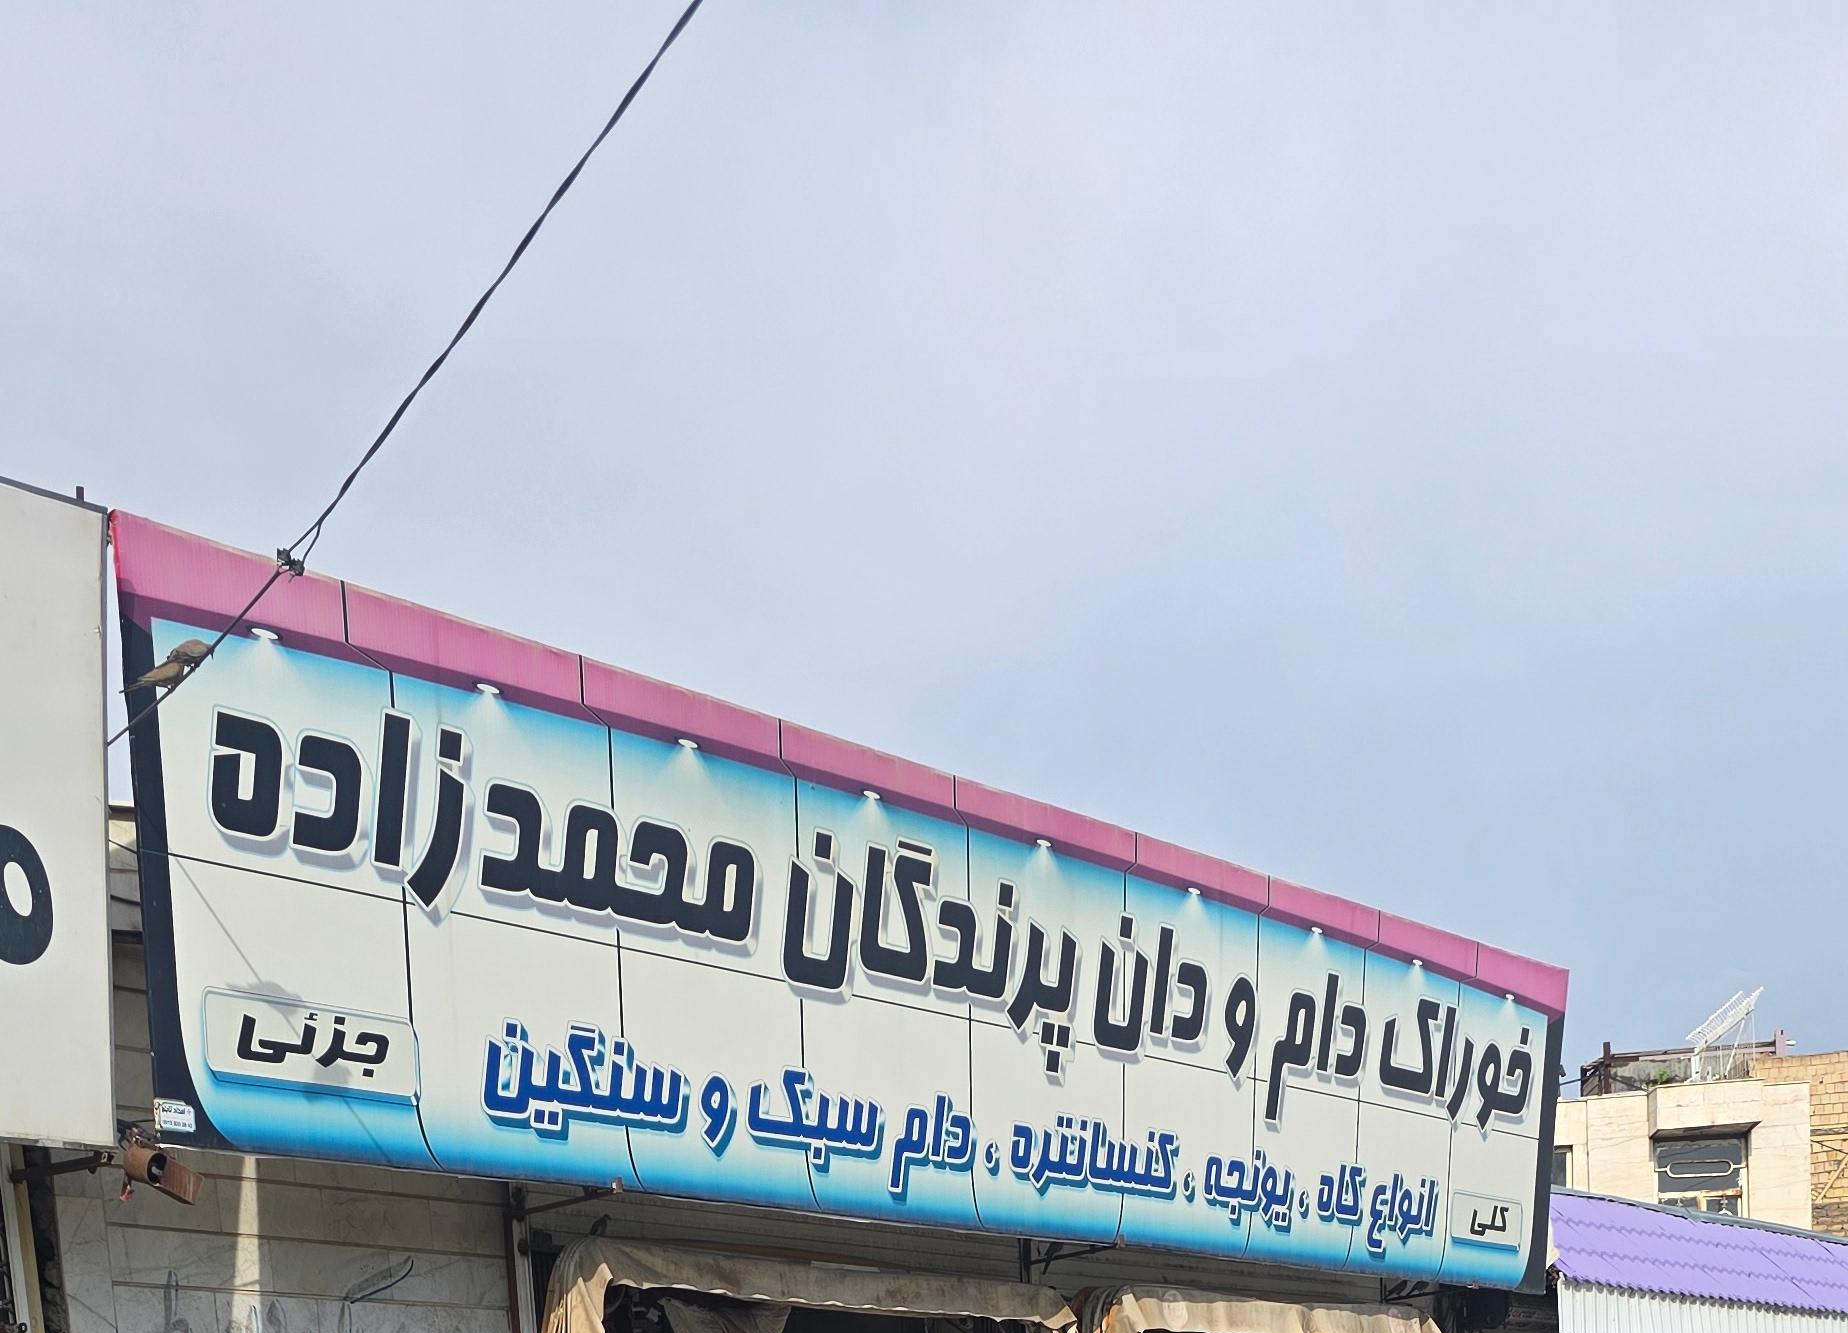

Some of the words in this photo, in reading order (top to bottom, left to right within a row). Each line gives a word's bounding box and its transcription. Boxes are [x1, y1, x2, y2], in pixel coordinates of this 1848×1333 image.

[210, 710, 756, 943] محمدزاده
[782, 830, 1078, 1075] پرندگان
[1092, 914, 1209, 1053] دان
[235, 1012, 391, 1079] جزئی
[482, 1021, 683, 1128] سنگین
[1223, 976, 1257, 1079] و
[1264, 972, 1368, 1122] دام
[1378, 997, 1533, 1132] خوراک
[699, 1075, 730, 1145] و
[746, 1069, 880, 1165] سبک
[889, 1093, 973, 1190] دام
[1009, 1113, 1177, 1191] کنسانتره
[1203, 1149, 1293, 1233] یونجه
[1316, 1163, 1363, 1217] کاه
[1366, 1173, 1437, 1250] انواع
[1469, 1204, 1510, 1237] کلی
